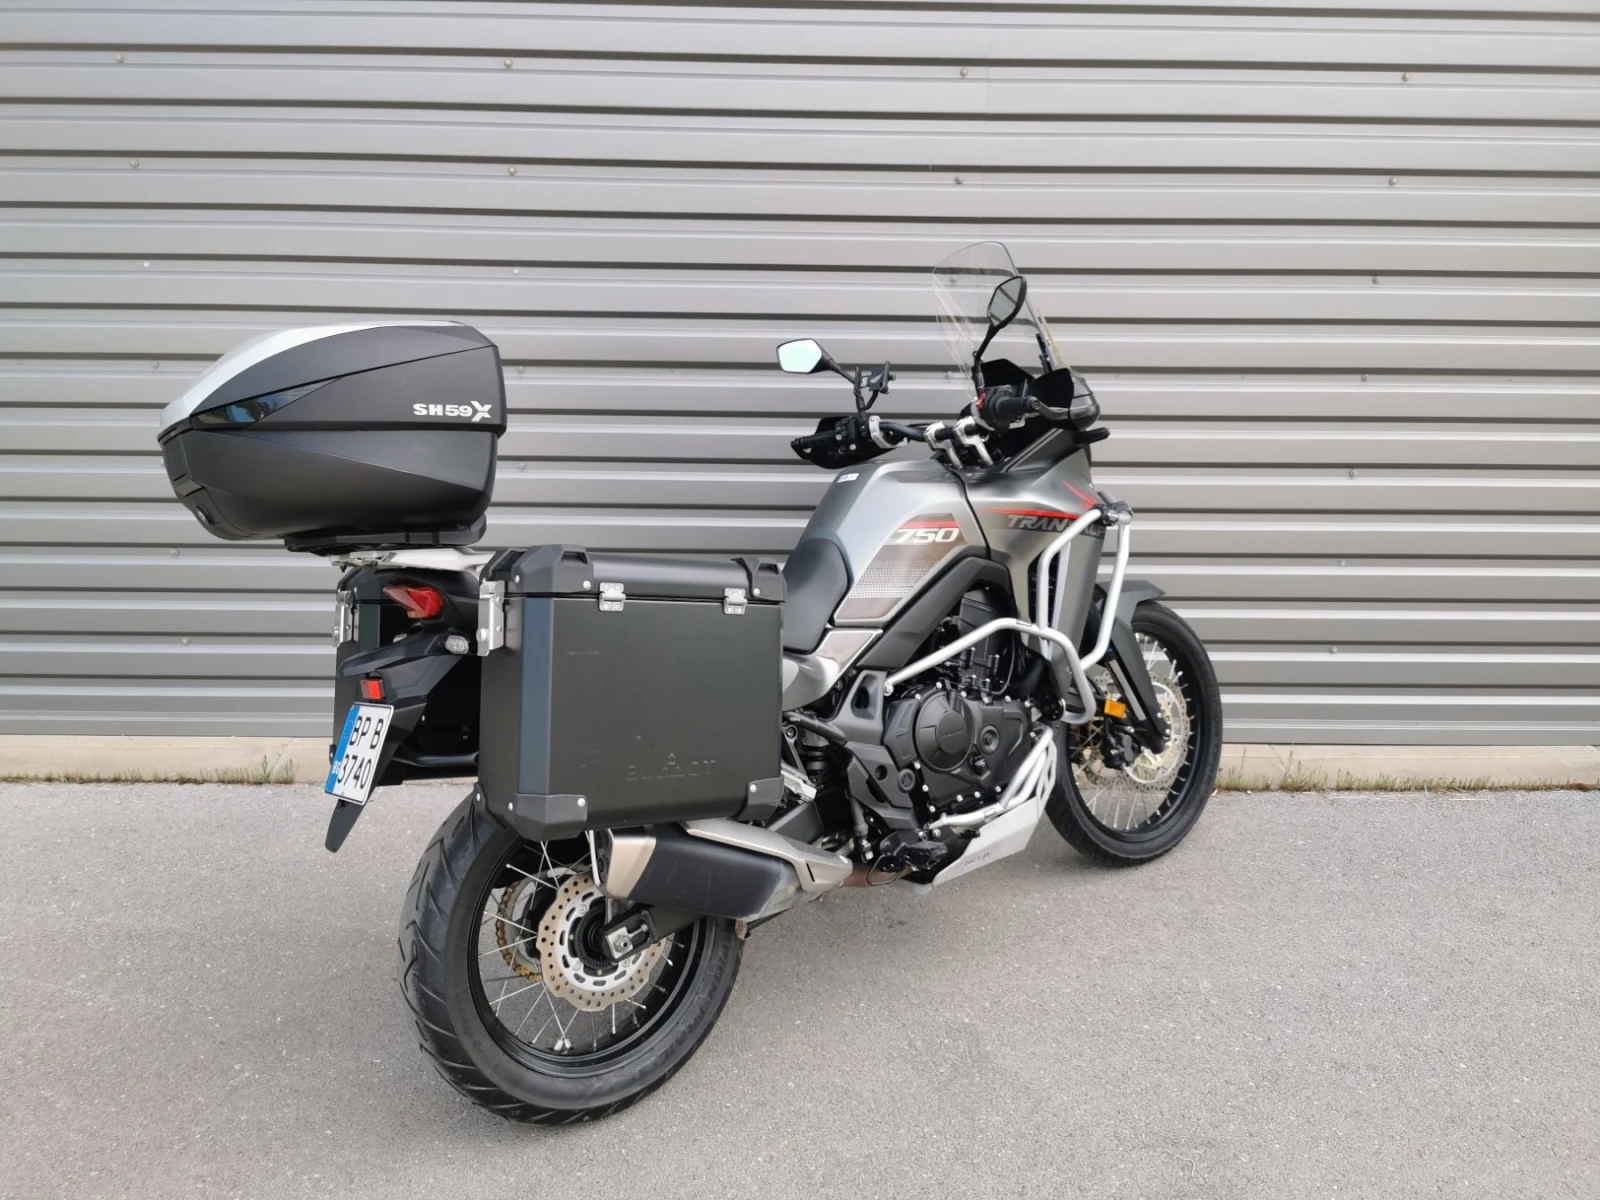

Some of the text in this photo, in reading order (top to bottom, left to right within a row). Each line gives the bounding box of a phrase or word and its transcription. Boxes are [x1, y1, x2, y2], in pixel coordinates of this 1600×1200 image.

[895, 527, 960, 544] 750
[1007, 514, 1106, 538] TRANLP
[350, 716, 384, 749] BP B
[338, 754, 372, 789] 3740
